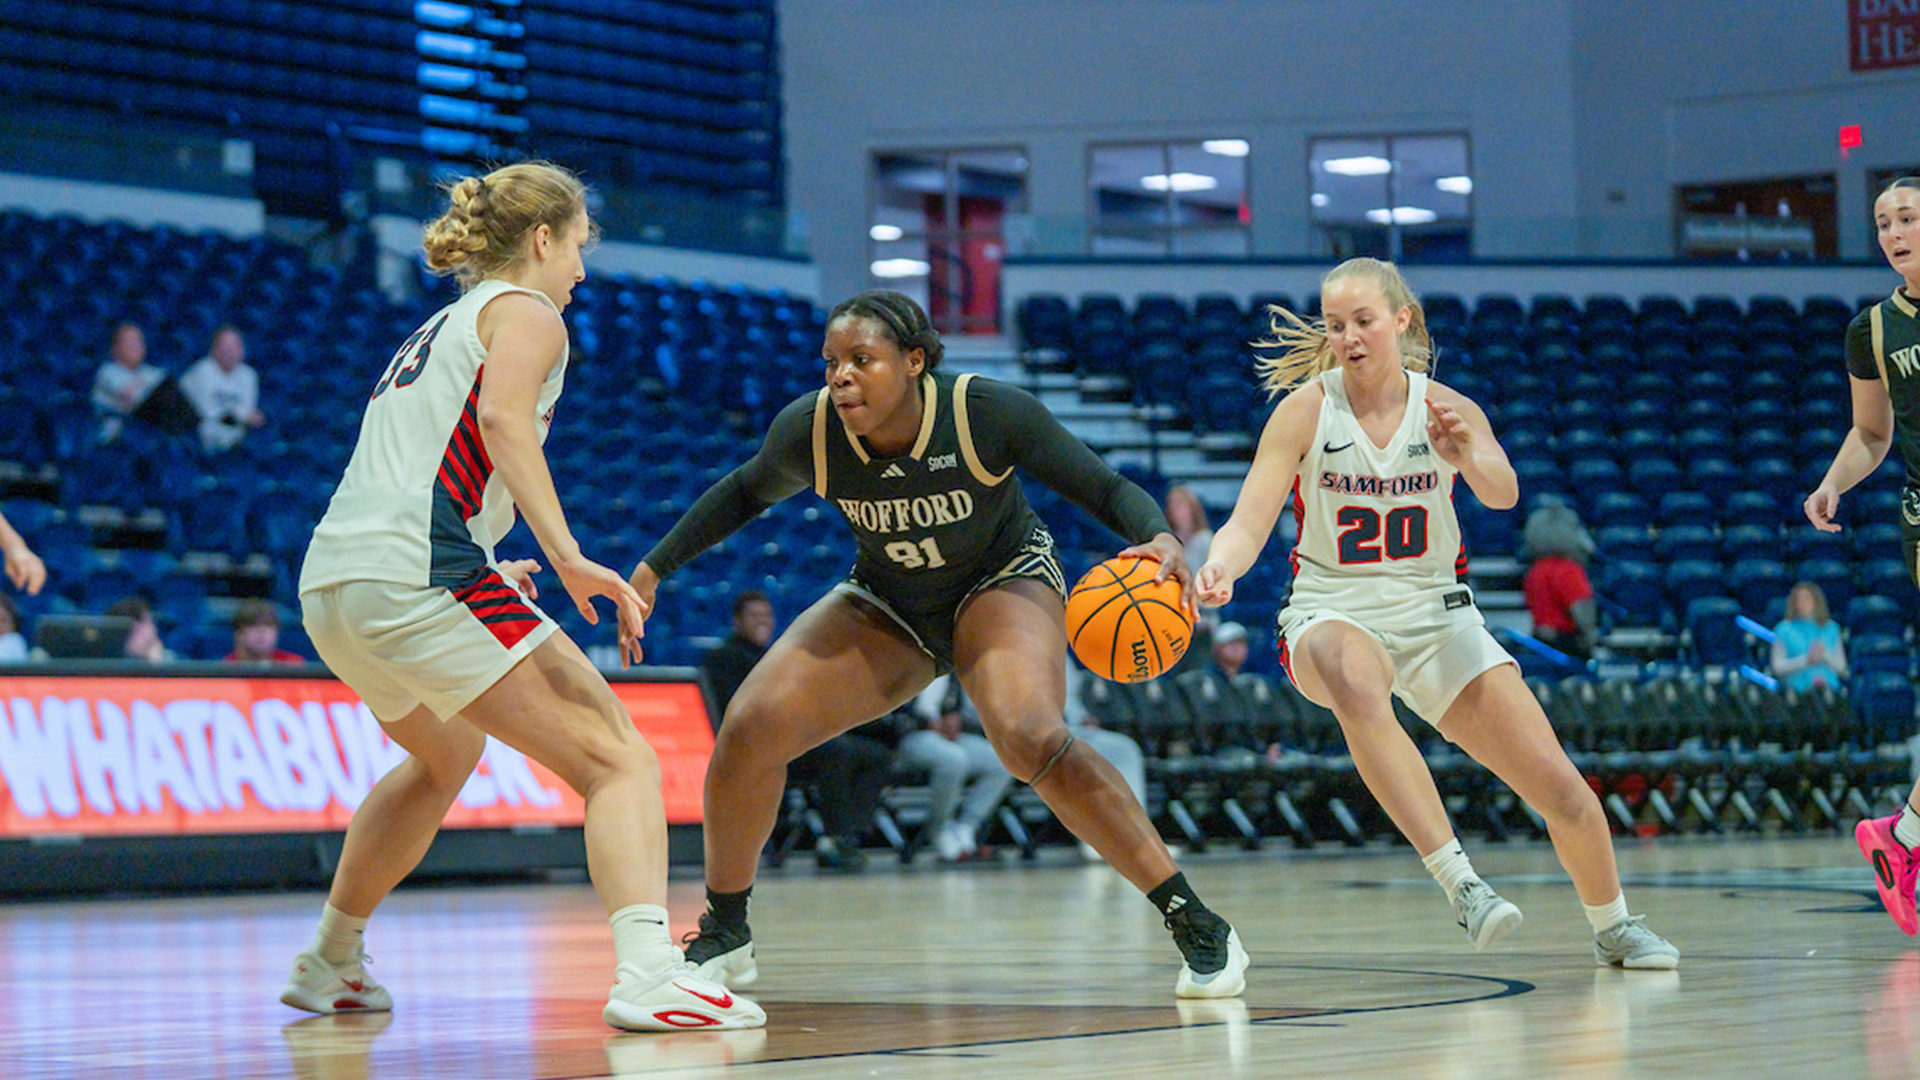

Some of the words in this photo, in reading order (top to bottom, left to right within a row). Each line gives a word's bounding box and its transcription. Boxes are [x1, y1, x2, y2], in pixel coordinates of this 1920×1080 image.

[1859, 23, 1920, 62] HE
[371, 312, 449, 400] 33
[1318, 468, 1439, 497] SAMFORD
[837, 489, 974, 533] WOFFORD
[884, 536, 946, 569] 91
[1337, 505, 1428, 565] 20
[0, 696, 554, 817] WHATABUER
